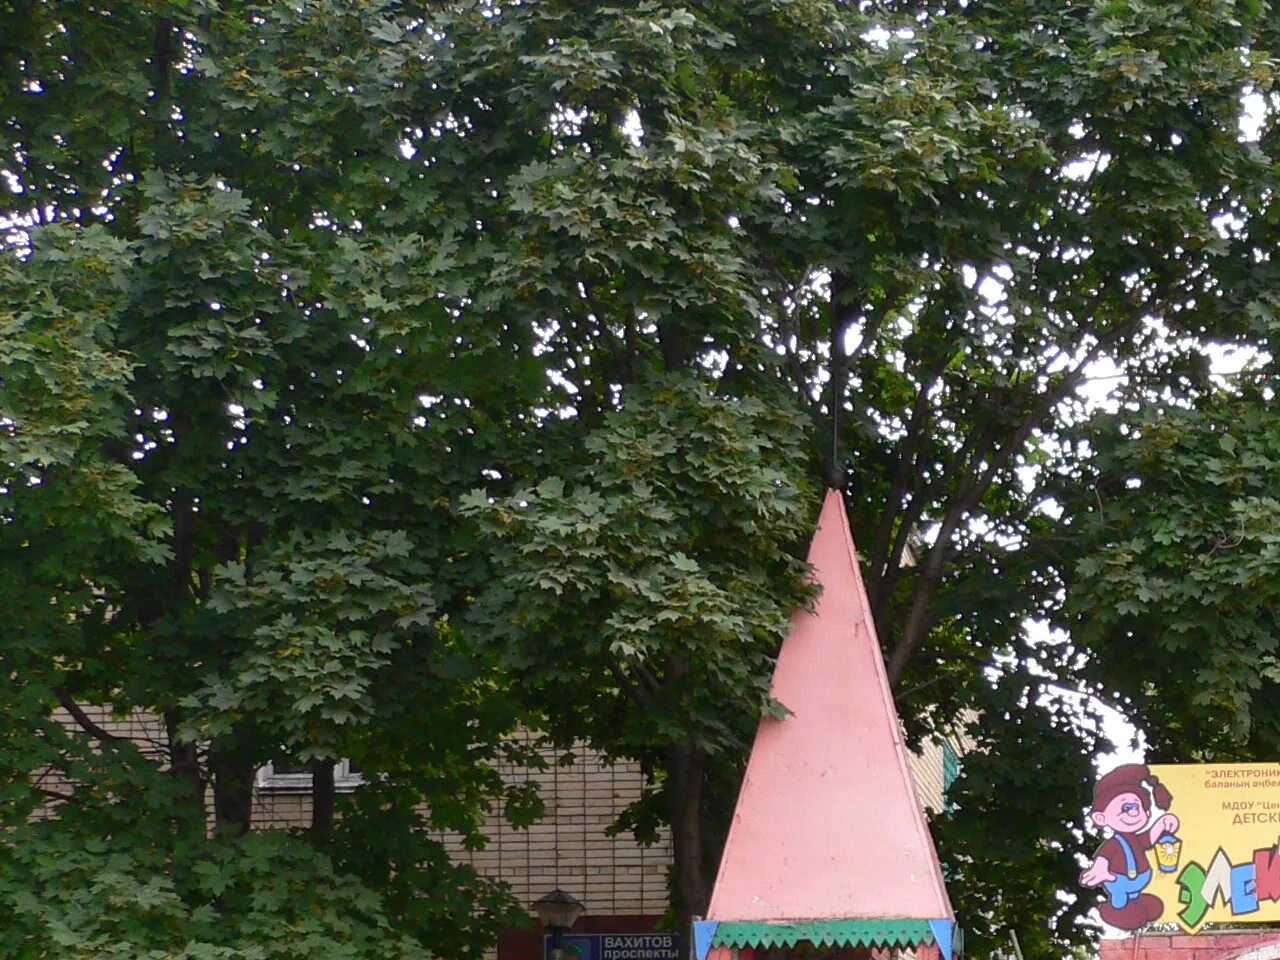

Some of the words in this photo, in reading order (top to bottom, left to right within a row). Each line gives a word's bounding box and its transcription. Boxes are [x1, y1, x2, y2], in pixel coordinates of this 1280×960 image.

[1222, 801, 1255, 811] МДОУ
[604, 936, 673, 948] ВАХИТОВ
[603, 949, 679, 960] проспекты
